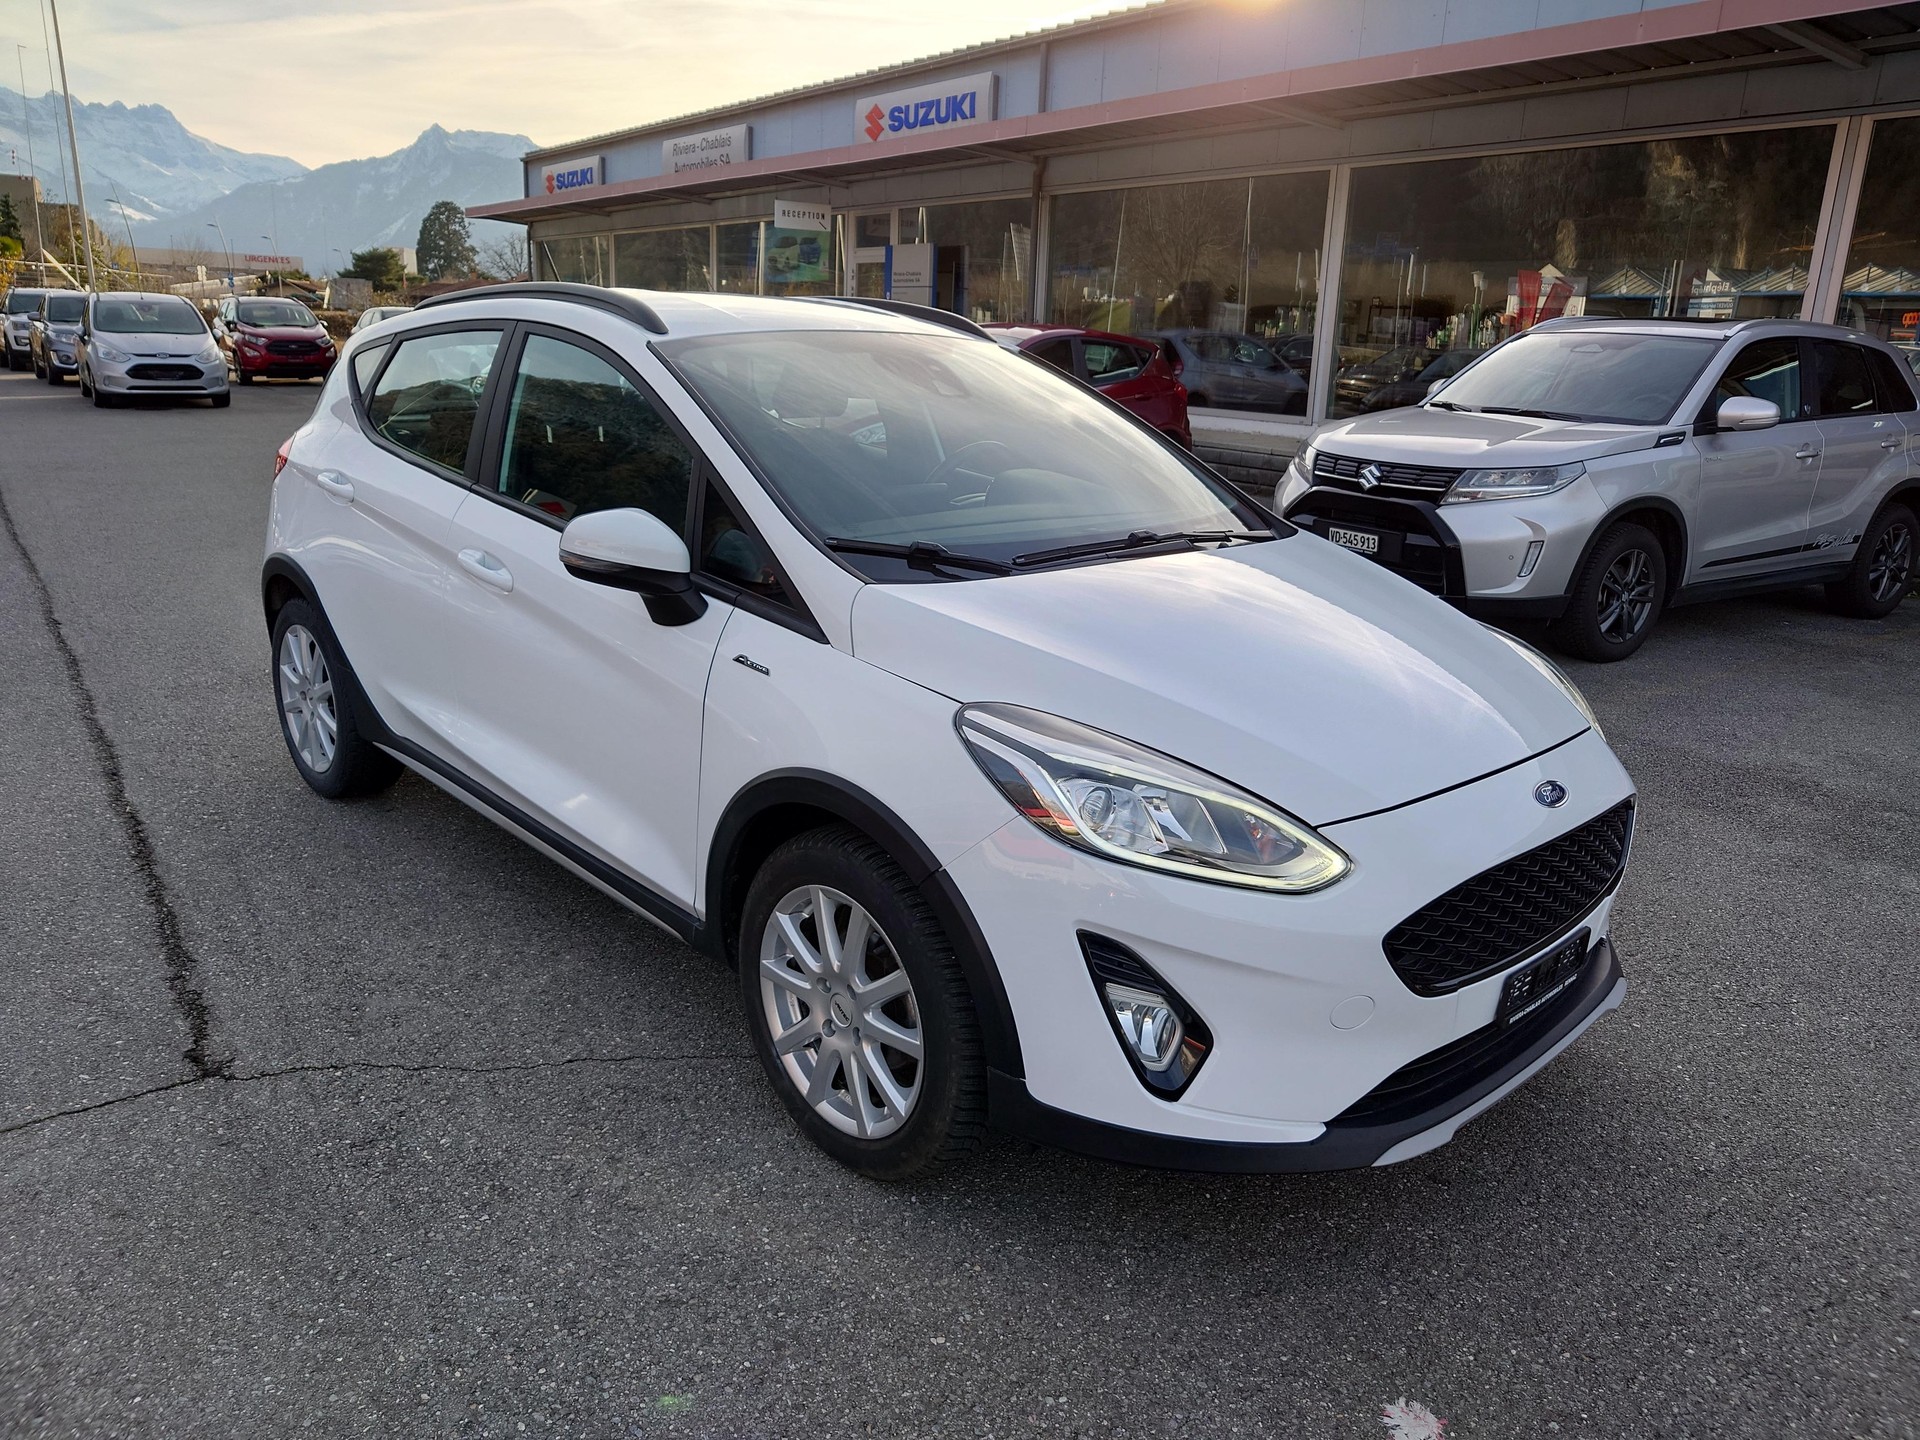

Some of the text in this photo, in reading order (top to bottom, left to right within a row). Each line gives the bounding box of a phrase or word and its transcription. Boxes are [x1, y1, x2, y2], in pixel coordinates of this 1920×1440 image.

[888, 91, 977, 132] SUZUKI
[556, 167, 593, 190] SUZUKI
[782, 209, 825, 221] RECEPTION
[244, 255, 290, 264] URGENCES
[1541, 784, 1563, 802] Ford
